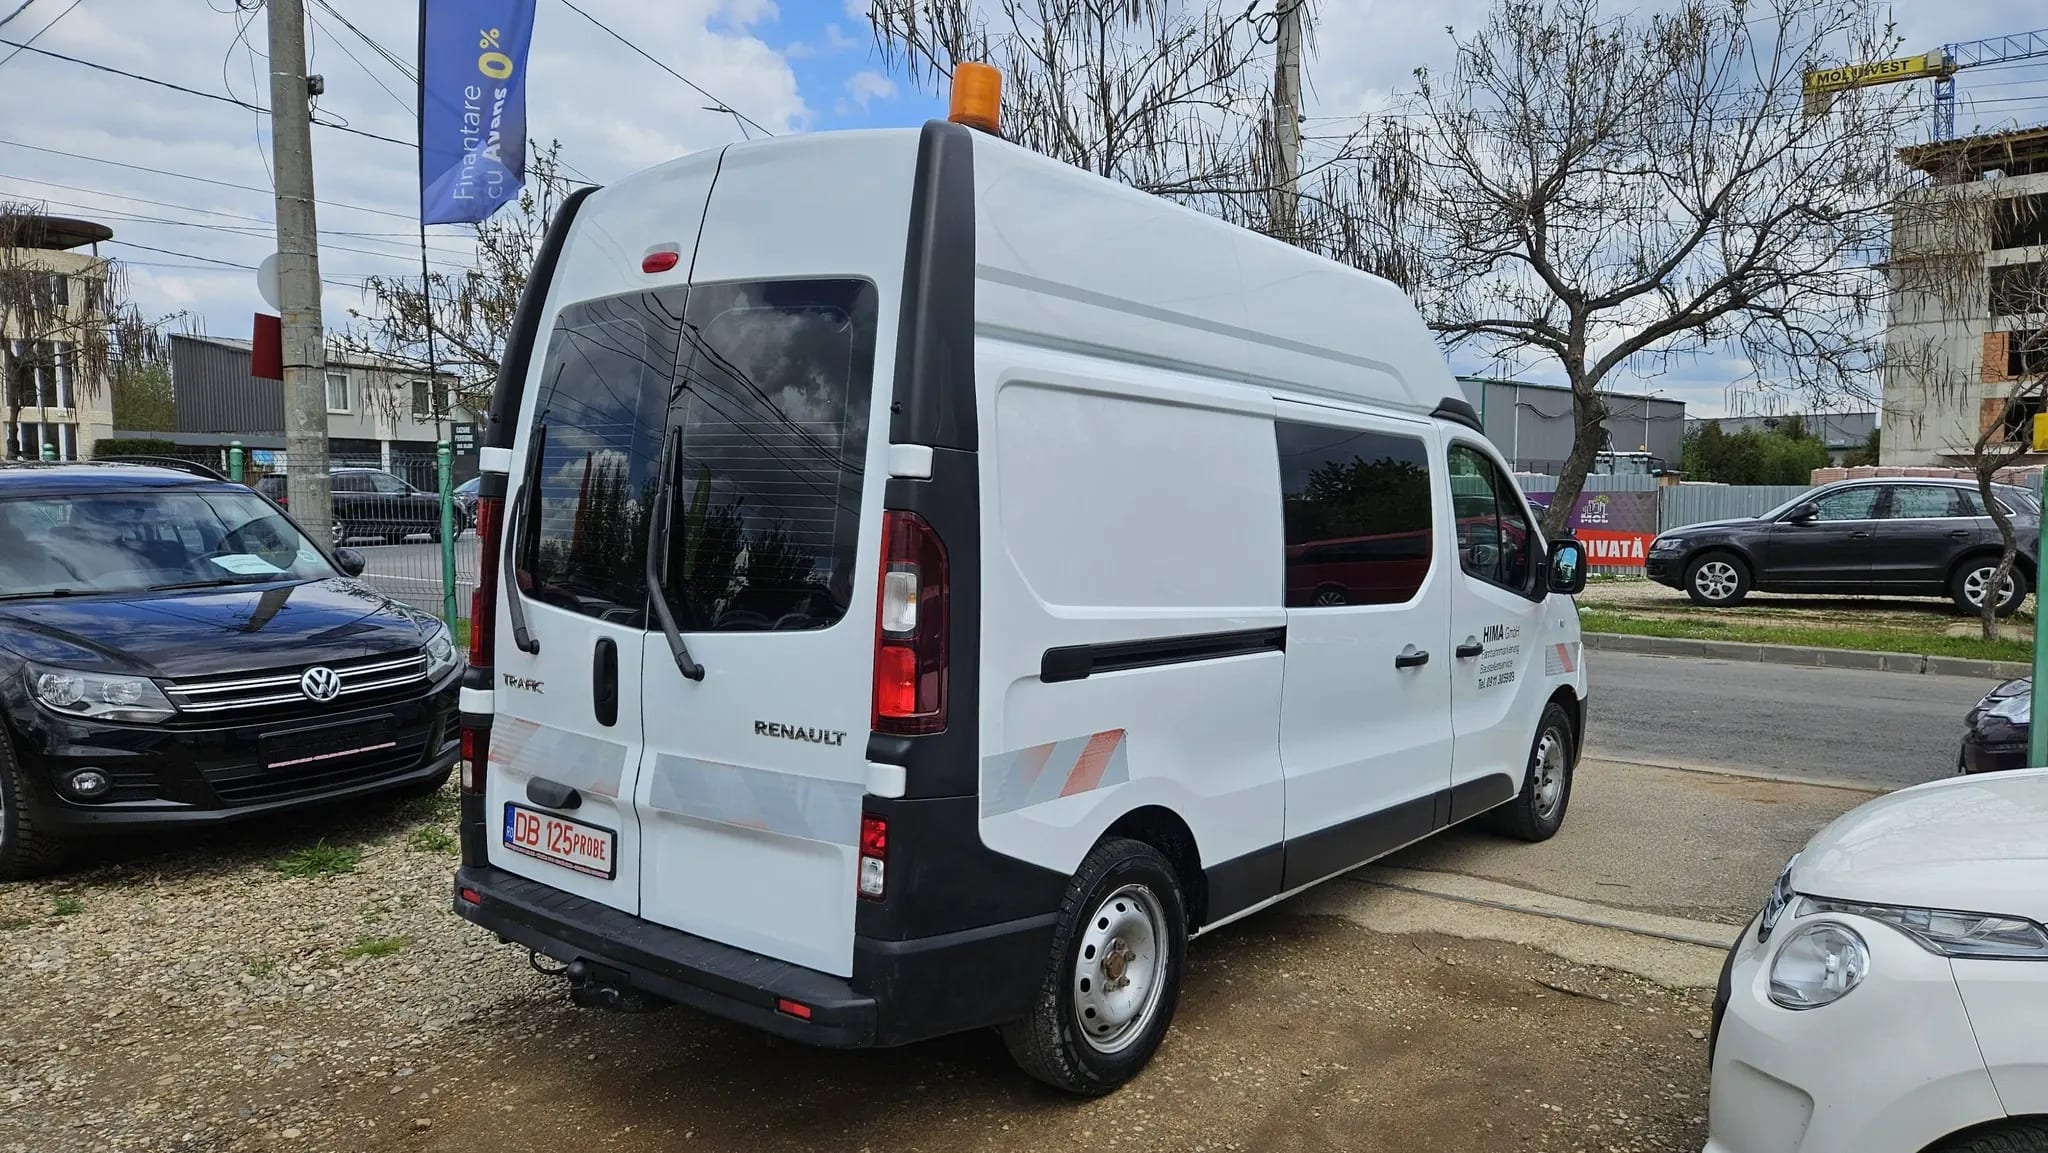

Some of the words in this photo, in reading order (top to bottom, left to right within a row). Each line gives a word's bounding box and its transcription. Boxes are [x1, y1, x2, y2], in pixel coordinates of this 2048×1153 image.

[478, 27, 514, 80] 0%
[453, 85, 481, 200] Finantare
[482, 87, 507, 163] Avans
[488, 170, 504, 199] cu
[1581, 513, 1608, 523] MOL
[1483, 624, 1503, 643] HIMA
[1505, 626, 1519, 639] GmbH
[755, 720, 847, 746] RENAULT
[515, 811, 540, 846] DB
[546, 821, 574, 856] 125
[573, 833, 606, 861] PROBE
